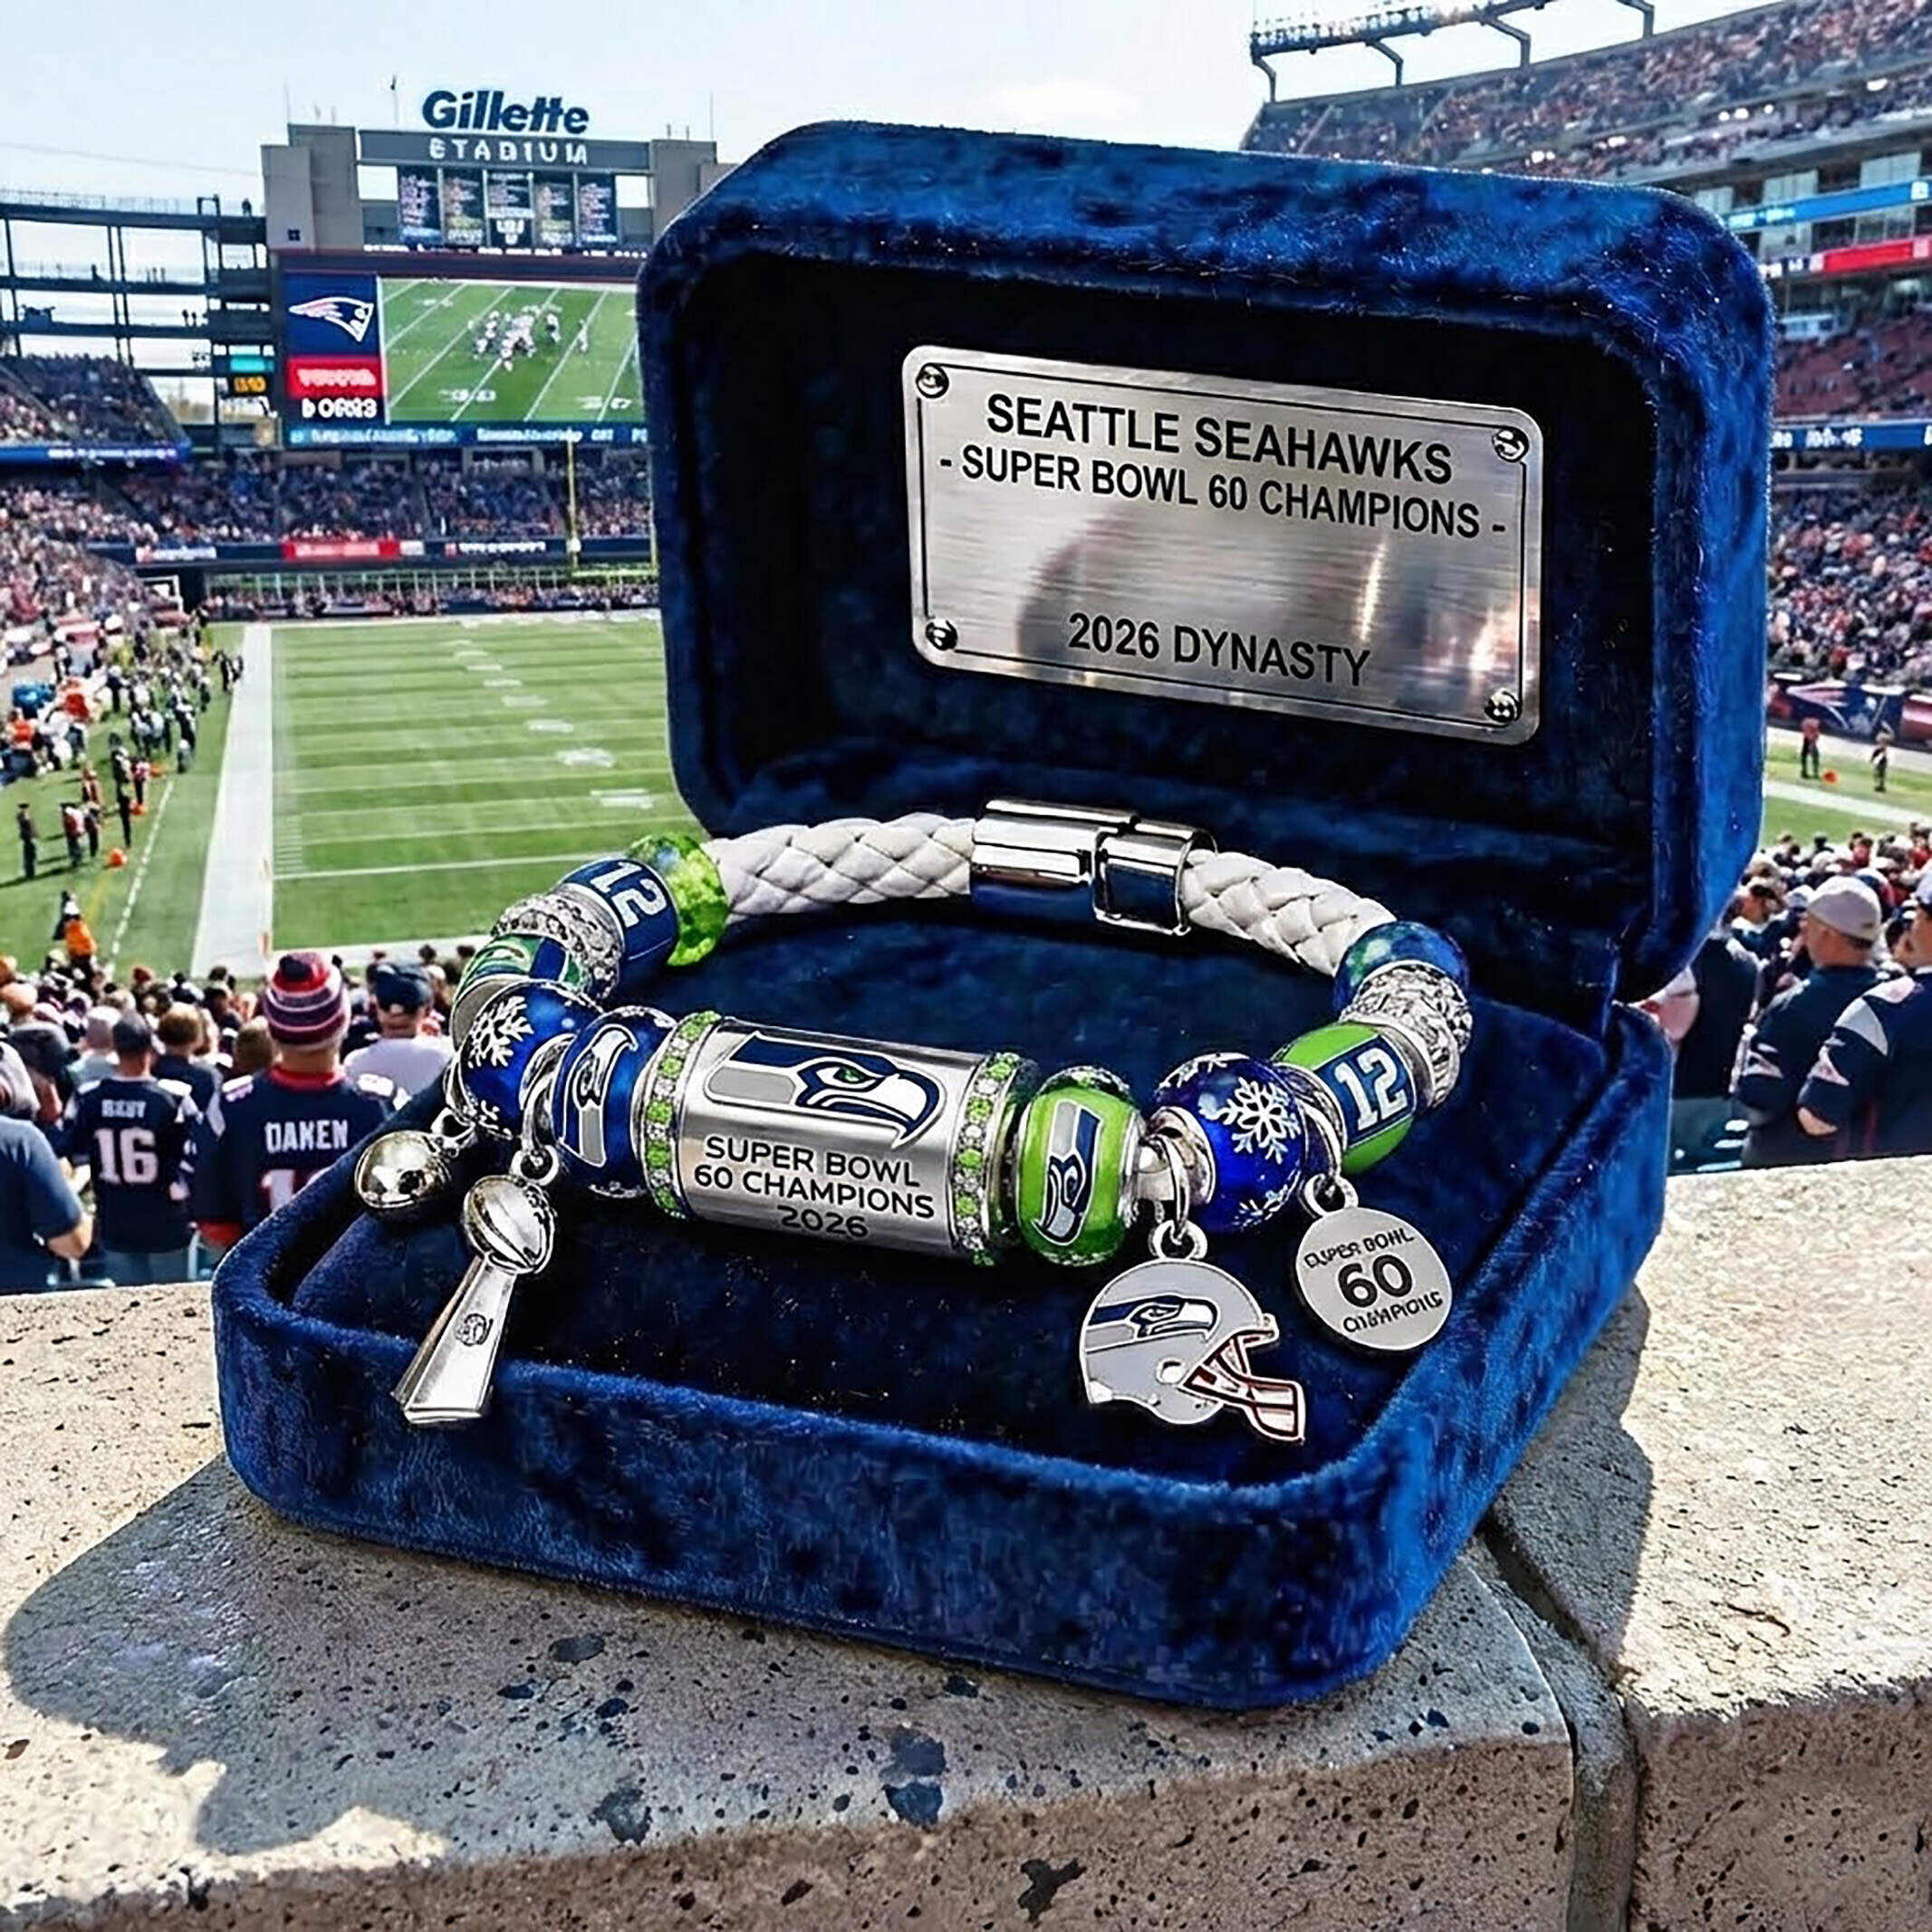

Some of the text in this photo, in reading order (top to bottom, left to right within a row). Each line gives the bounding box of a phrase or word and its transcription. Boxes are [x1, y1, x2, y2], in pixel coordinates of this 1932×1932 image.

[422, 90, 590, 135] Gillette
[986, 393, 1453, 485] SEATTLE SEAHAWKS
[962, 444, 1081, 492] SUPER
[1091, 461, 1198, 506] BOWL
[1207, 475, 1248, 511] 60
[1260, 480, 1481, 539] CHAMPIONS
[1067, 612, 1370, 687] 2026 DYNASTY
[590, 860, 668, 928] 12
[1333, 1046, 1409, 1132] 12
[93, 1127, 159, 1184] 16
[705, 1135, 920, 1187] SUPER BOWL
[694, 1164, 935, 1219] 60 CHAMPIONS
[776, 1205, 869, 1238] 2026
[1338, 1254, 1413, 1308] 60
